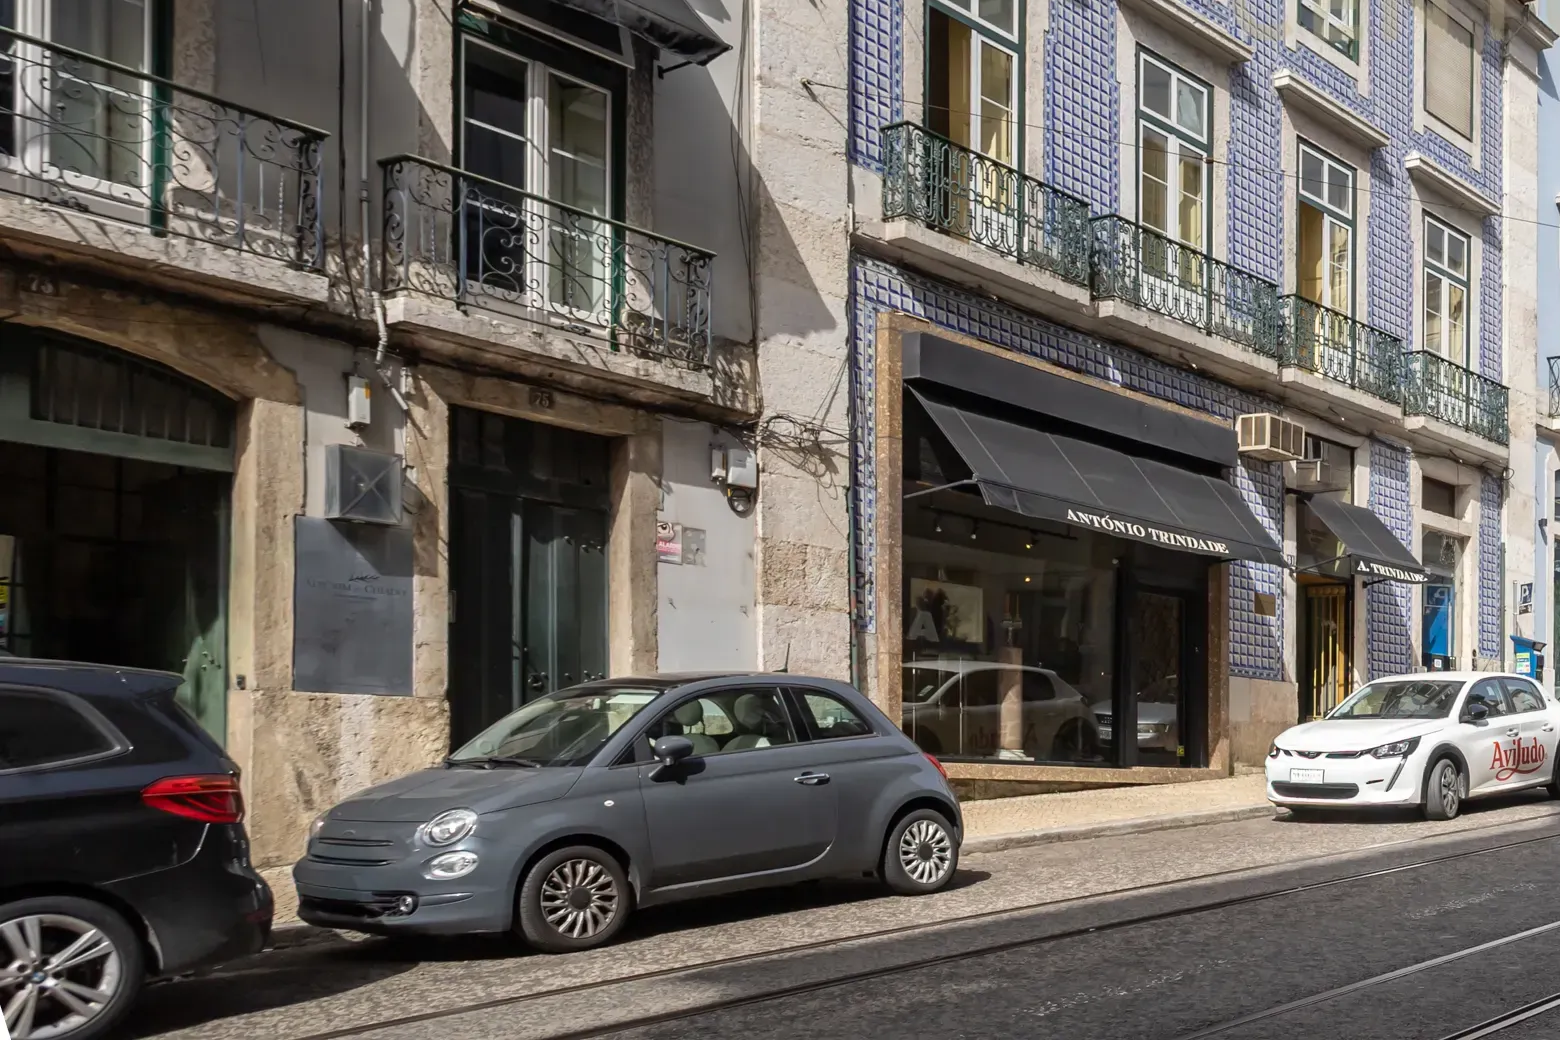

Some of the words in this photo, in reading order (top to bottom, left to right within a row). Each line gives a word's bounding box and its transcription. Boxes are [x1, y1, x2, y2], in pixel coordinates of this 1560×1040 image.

[1067, 508, 1146, 537] ANTÓNIO
[1148, 528, 1230, 554] TRINDADE
[1357, 560, 1370, 572] A.
